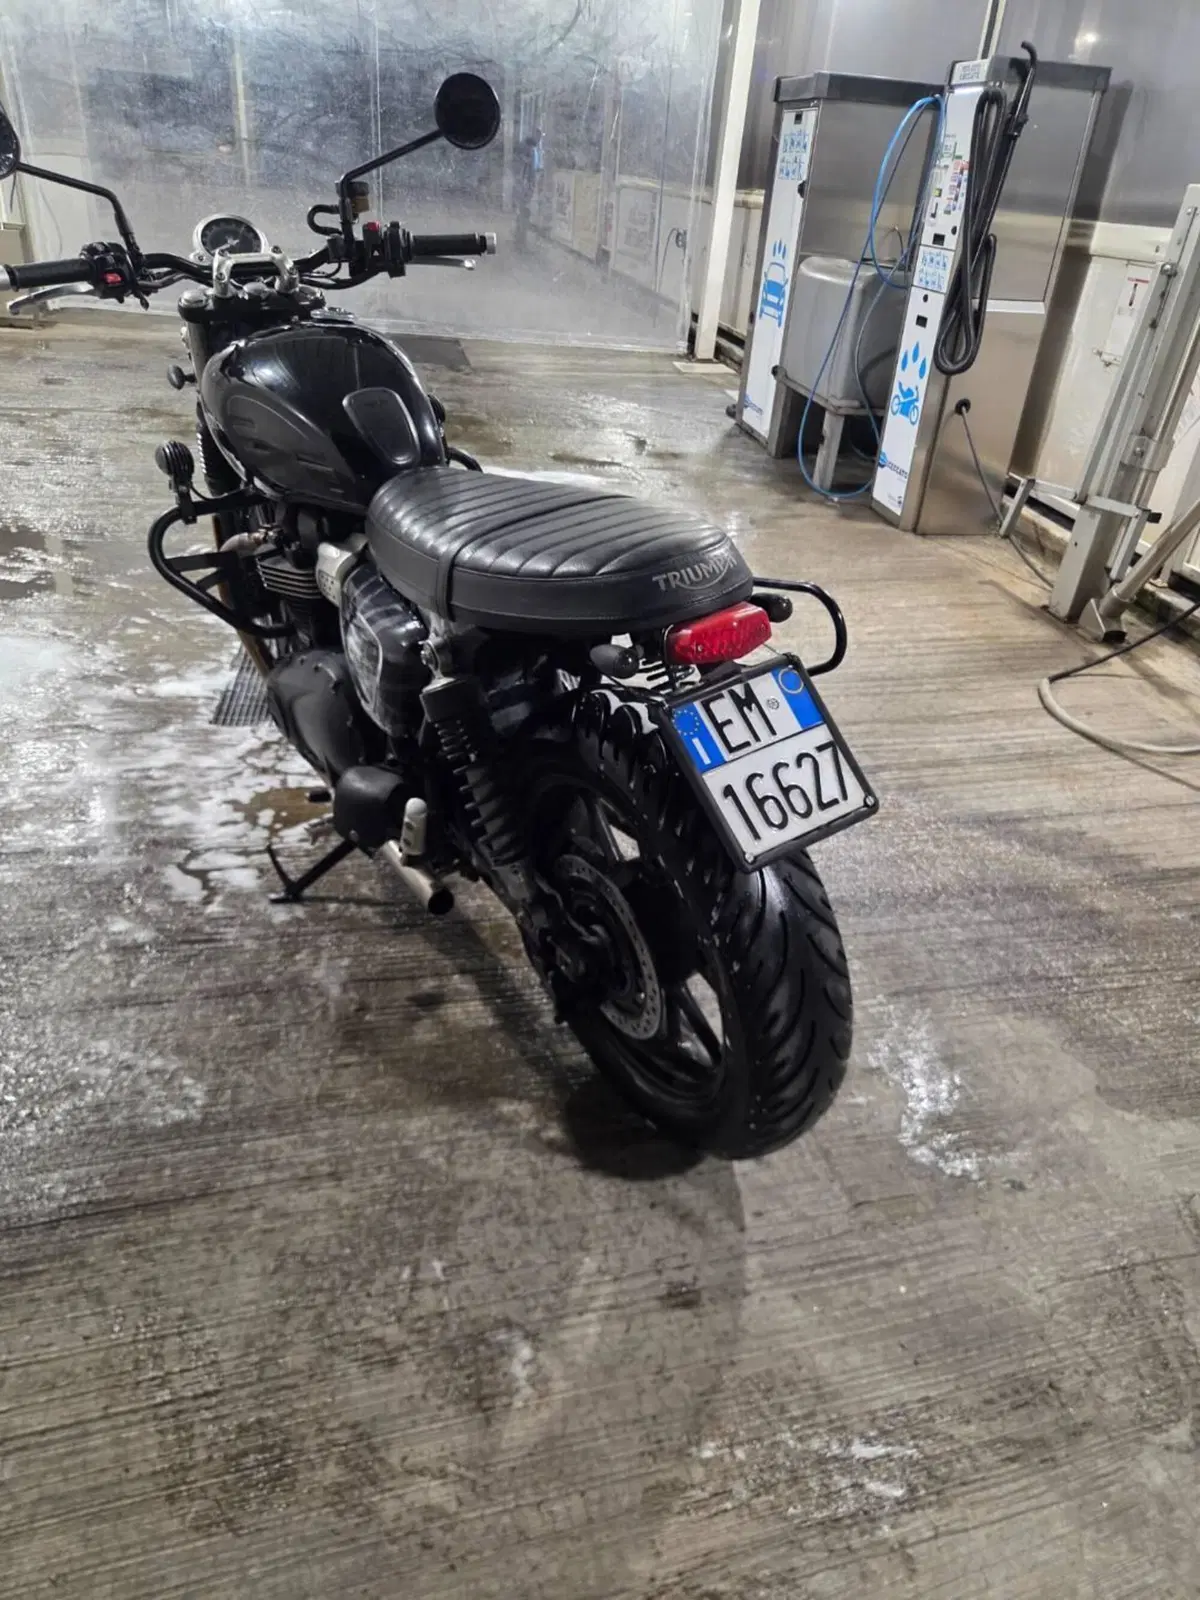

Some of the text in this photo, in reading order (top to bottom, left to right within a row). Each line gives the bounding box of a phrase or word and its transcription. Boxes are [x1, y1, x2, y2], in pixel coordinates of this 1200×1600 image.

[652, 554, 738, 592] TRIUMPH
[701, 682, 777, 754] EM
[692, 737, 711, 765] I
[723, 740, 848, 841] 16627
